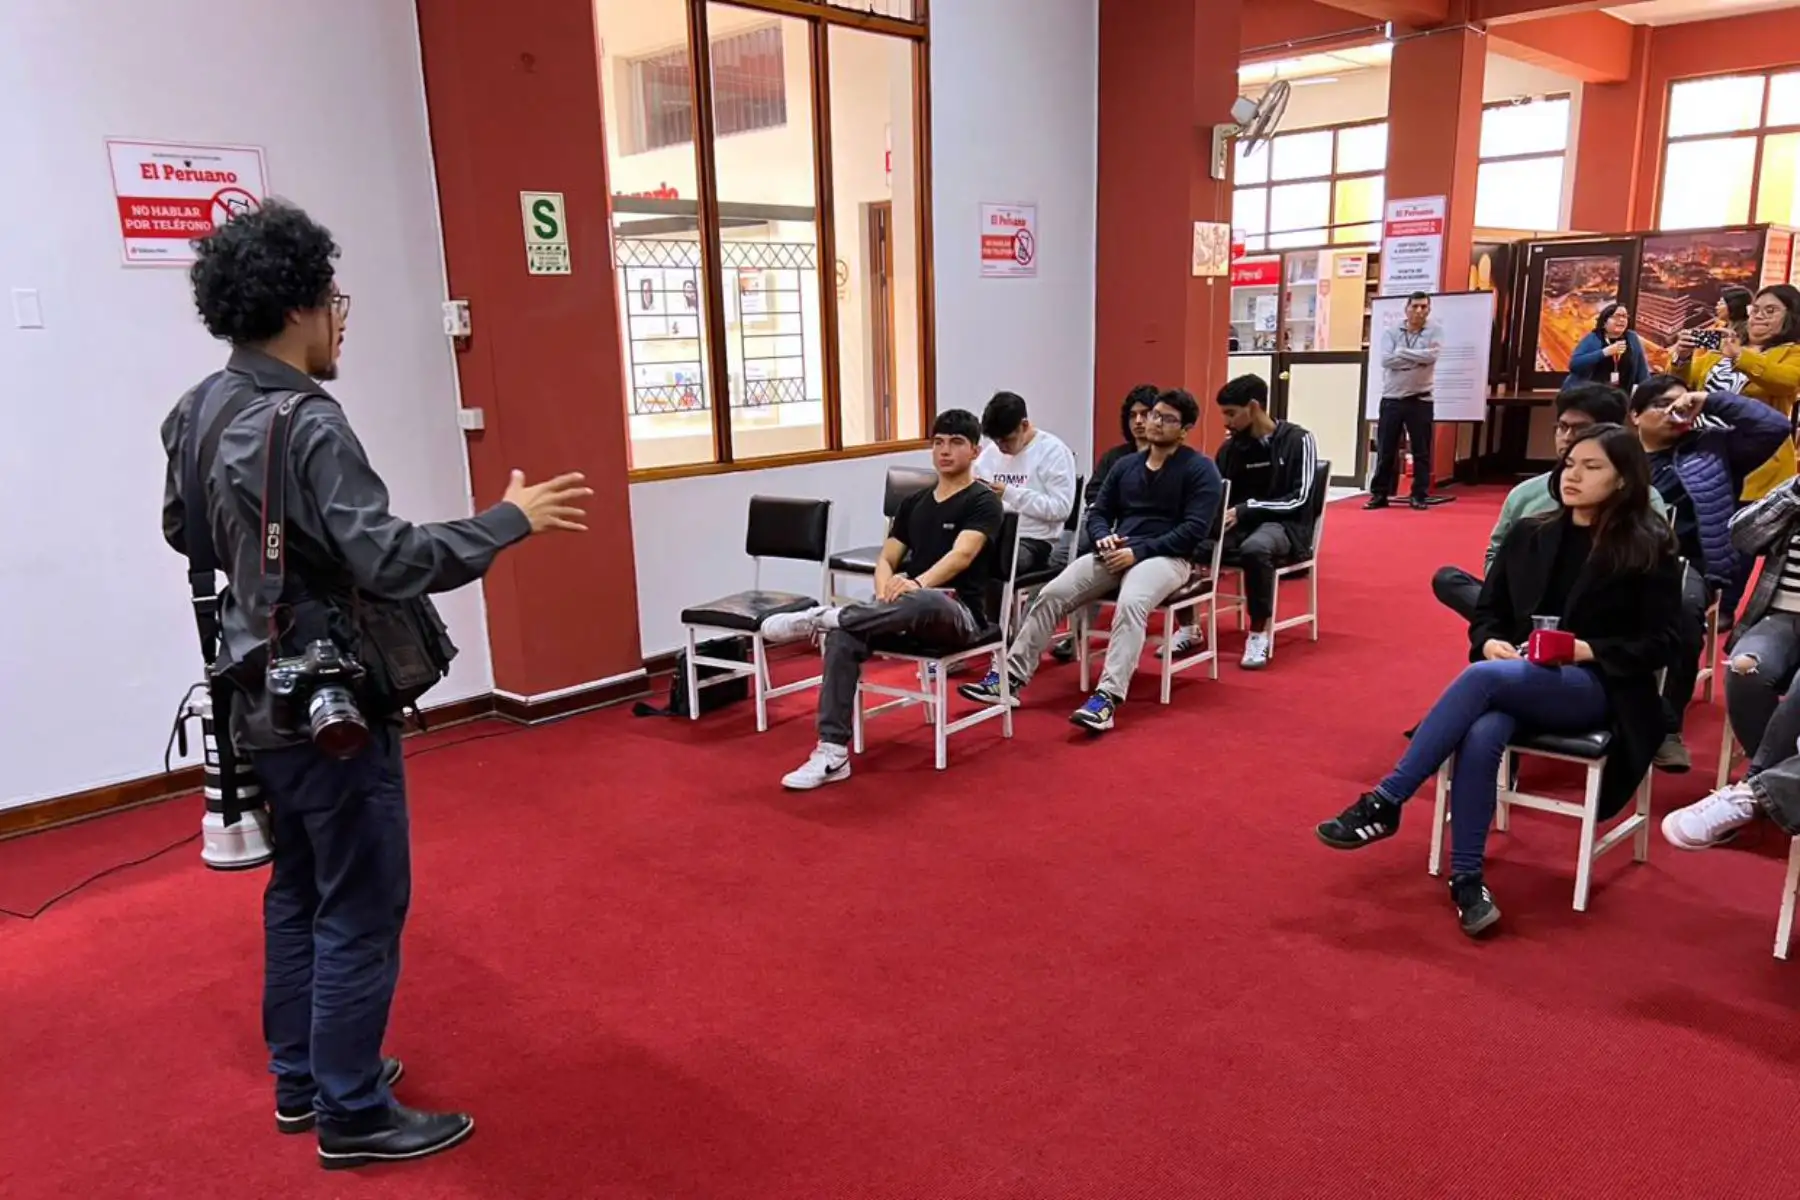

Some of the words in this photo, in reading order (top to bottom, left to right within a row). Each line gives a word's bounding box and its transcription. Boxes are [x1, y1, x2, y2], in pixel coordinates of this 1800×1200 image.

[140, 163, 160, 179] El
[163, 164, 237, 183] Peruano
[131, 204, 150, 216] NO
[151, 205, 201, 217] HABLAR
[532, 199, 558, 240] S
[125, 218, 151, 230] POR
[152, 218, 211, 231] TELÉFONO
[267, 522, 280, 560] EOS
